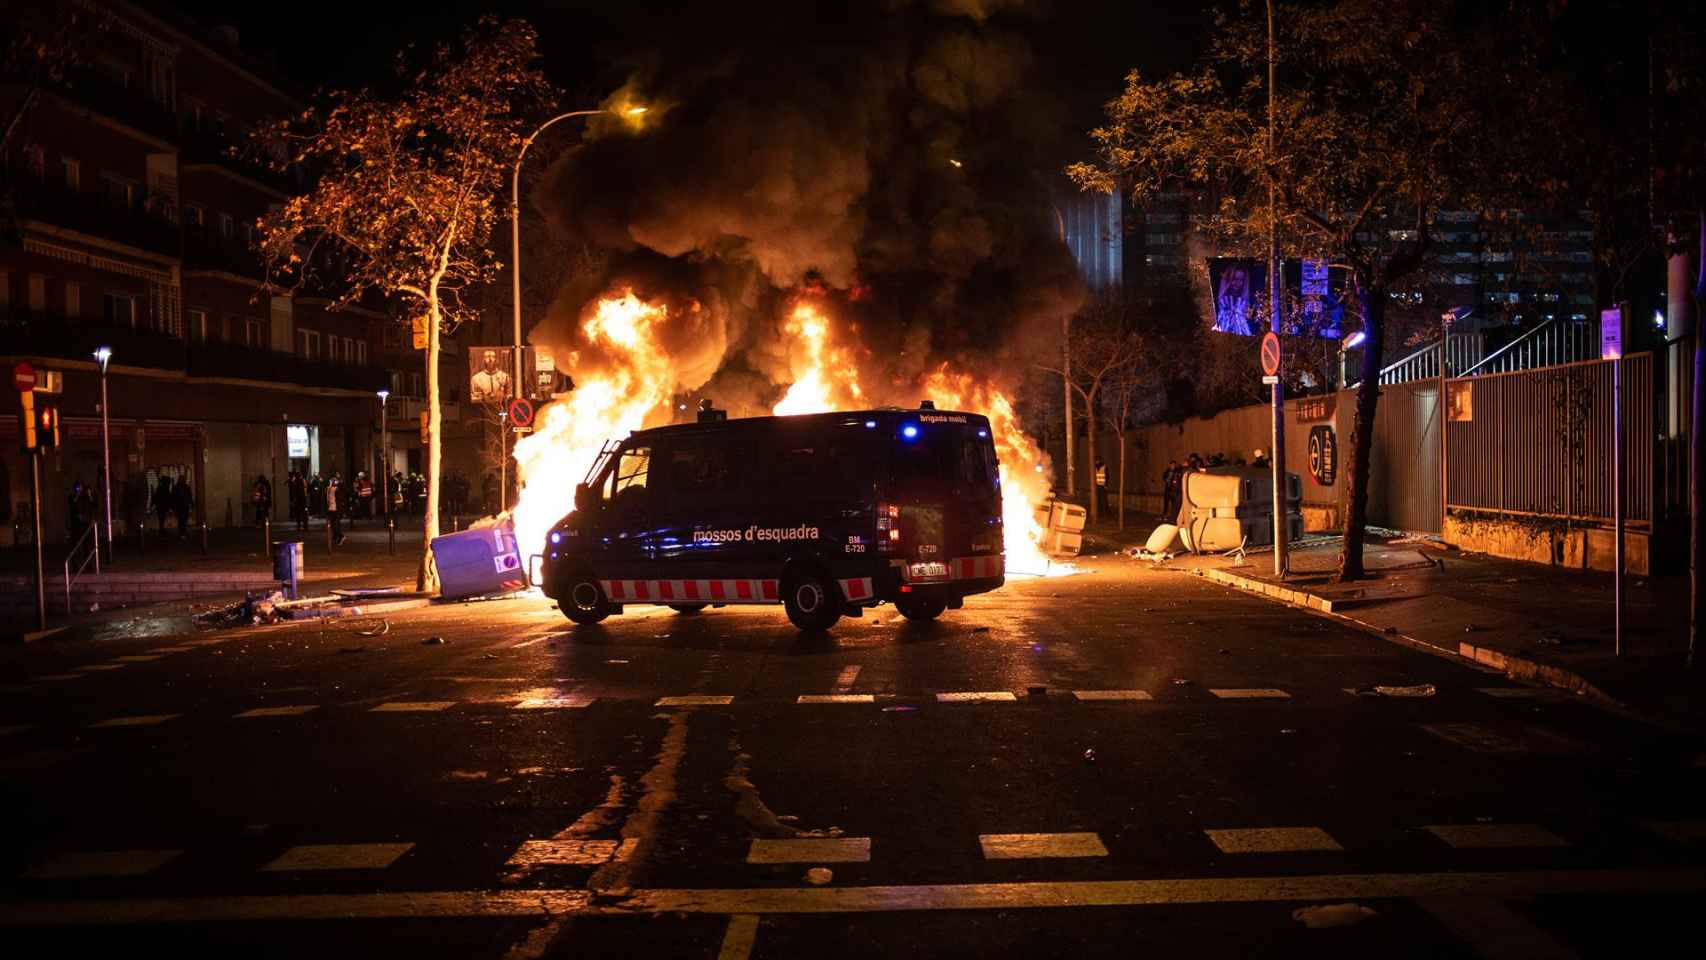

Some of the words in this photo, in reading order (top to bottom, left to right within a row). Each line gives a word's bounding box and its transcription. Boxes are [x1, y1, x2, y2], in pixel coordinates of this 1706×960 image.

[693, 528, 742, 542] mossos
[745, 523, 819, 544] d'esquadra
[845, 544, 865, 553] E-720
